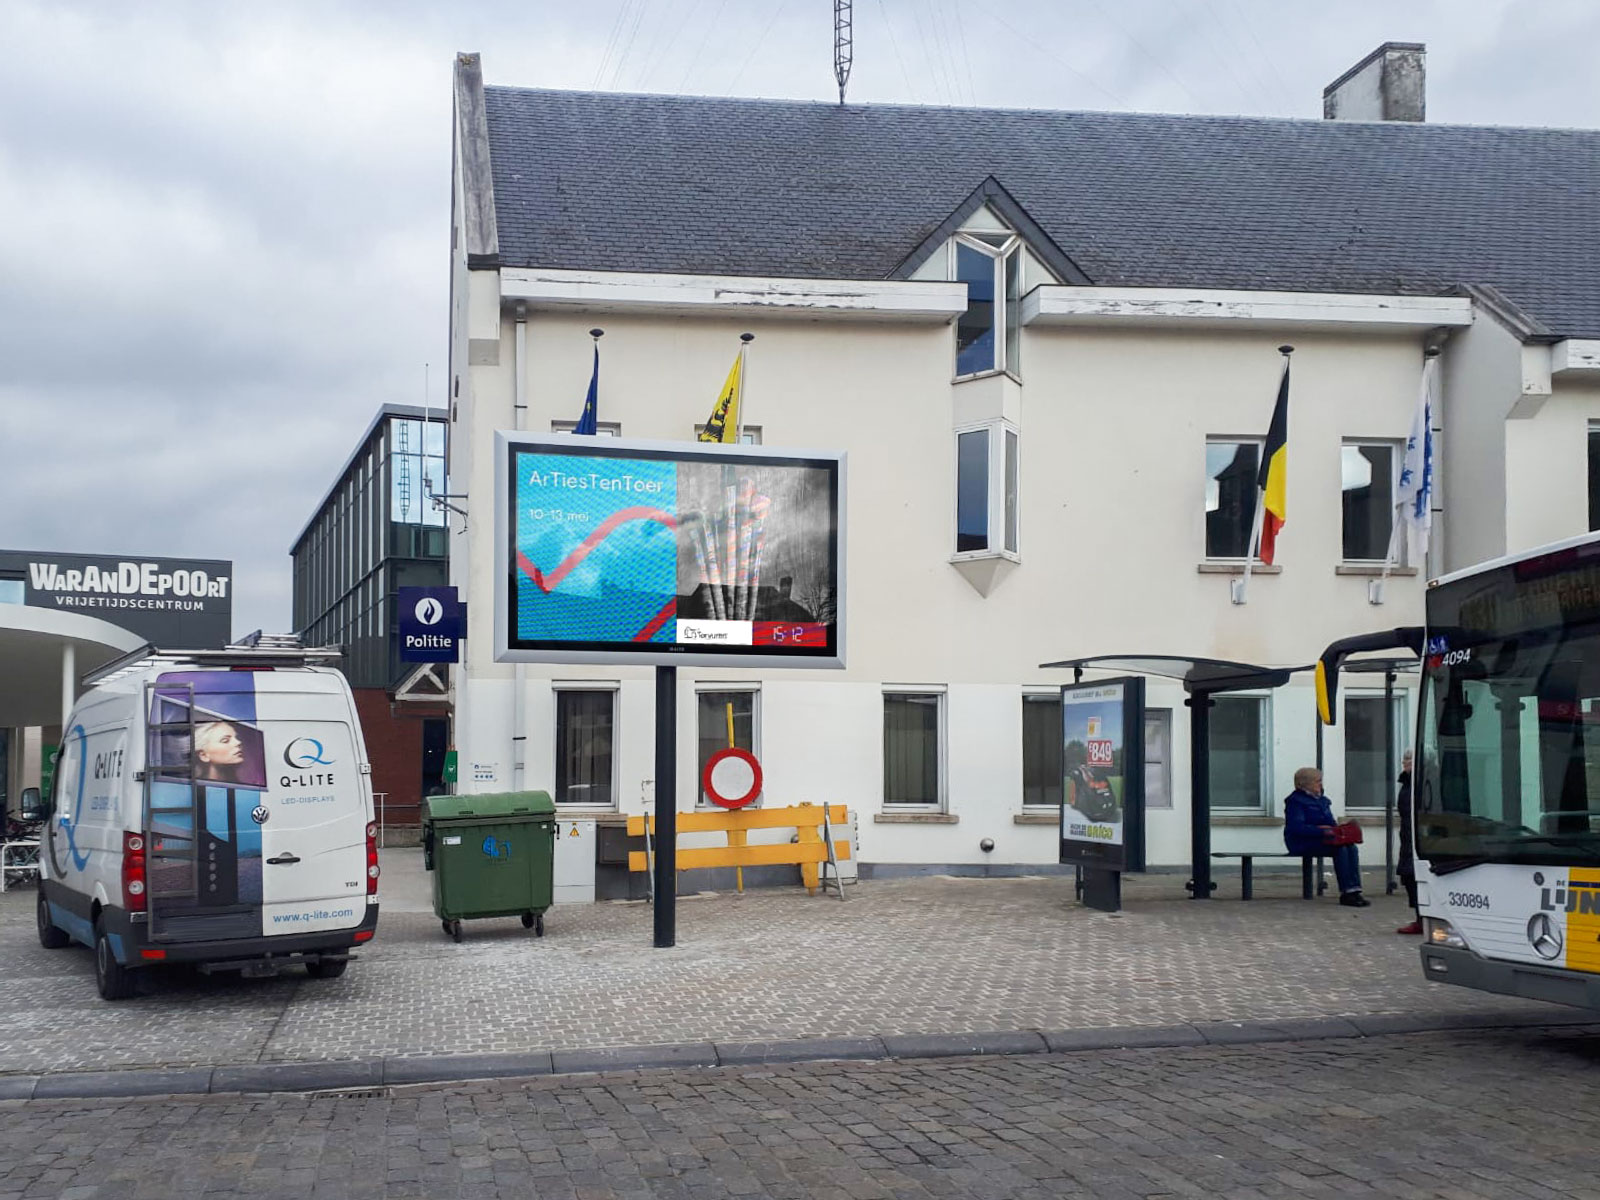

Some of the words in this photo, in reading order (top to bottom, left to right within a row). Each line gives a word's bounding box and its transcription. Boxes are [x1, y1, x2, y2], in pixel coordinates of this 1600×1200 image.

[529, 470, 663, 493] ArTiesTenToer
[55, 595, 204, 611] VRIJETIJDSCENTRUM
[406, 634, 452, 647] Politie
[1442, 648, 1471, 666] 4094
[280, 773, 335, 788] Q-LITE
[1448, 891, 1489, 910] 330894
[272, 908, 353, 923] www.q-lite.com
